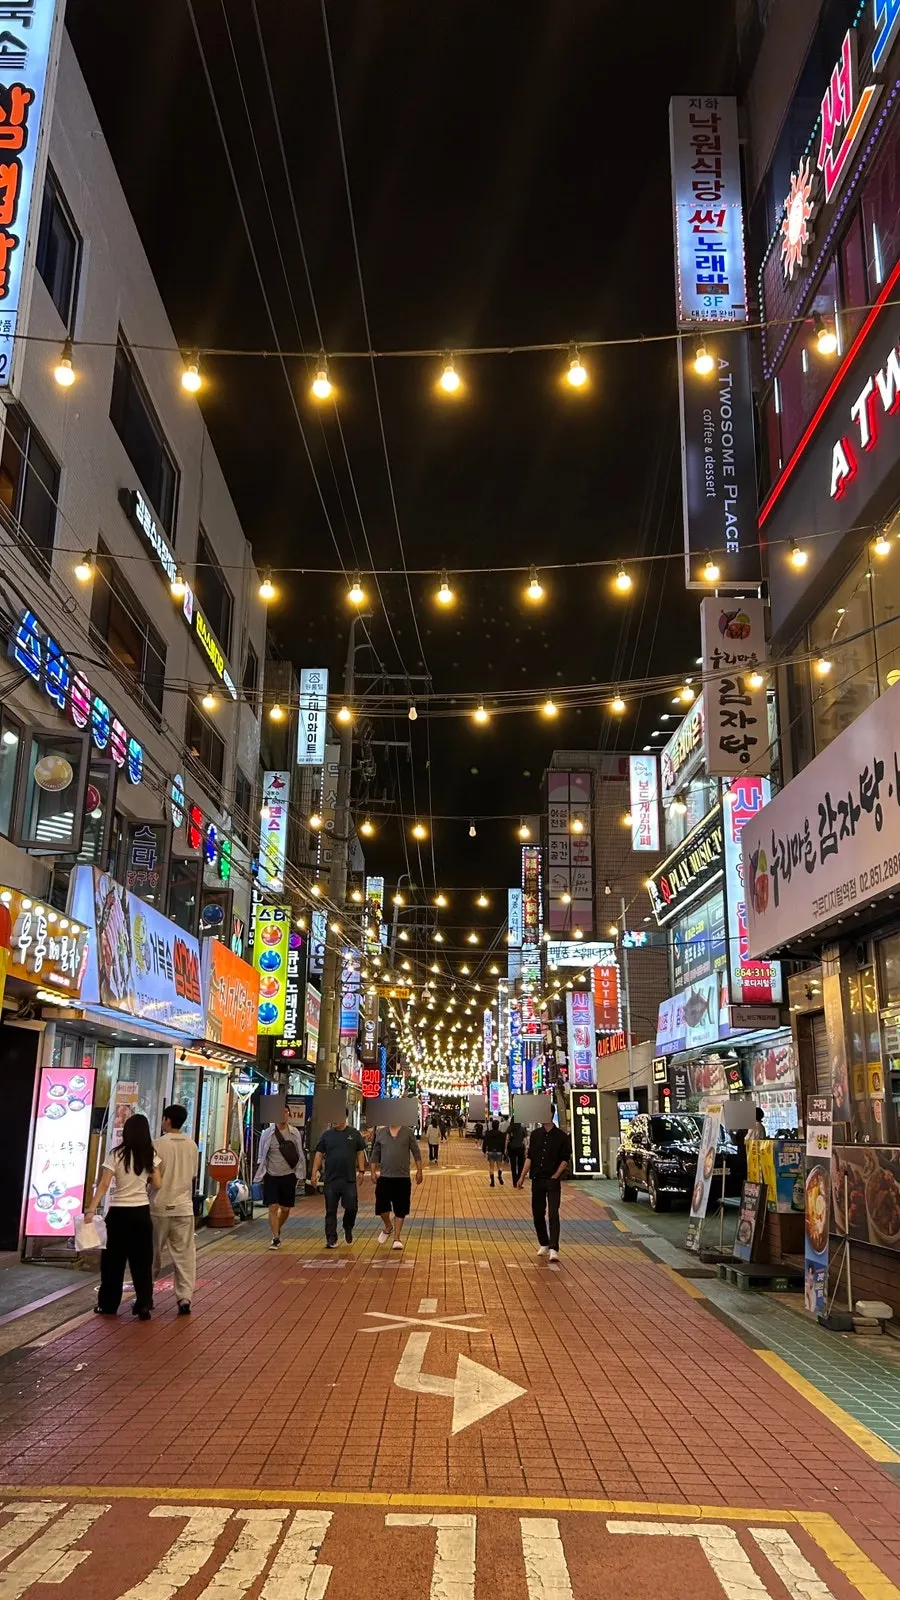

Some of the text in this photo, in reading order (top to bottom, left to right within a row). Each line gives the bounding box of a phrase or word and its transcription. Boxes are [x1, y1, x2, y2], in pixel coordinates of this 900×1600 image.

[688, 98, 719, 110] 지하
[689, 112, 726, 202] 낙원식당
[687, 209, 727, 234] 썬
[703, 295, 724, 307] 3F
[718, 374, 735, 477] TWOSOME
[703, 409, 717, 498] coffee & dessert
[723, 484, 740, 553] PLACE
[306, 691, 320, 754] 스테이화이트
[718, 677, 758, 764] 감자탕
[638, 780, 652, 846] 보드게임카페
[770, 816, 818, 908] 누리마을
[818, 757, 885, 865] 감자탕
[132, 826, 158, 871] 스타
[551, 841, 568, 850] 주거
[551, 851, 568, 860] 공간
[668, 857, 697, 898] PLAY
[812, 877, 858, 918] 구로디지털역점
[283, 979, 298, 1039] 노래타운
[600, 968, 611, 1019] MOTEL
[610, 1031, 627, 1054] MOTEL
